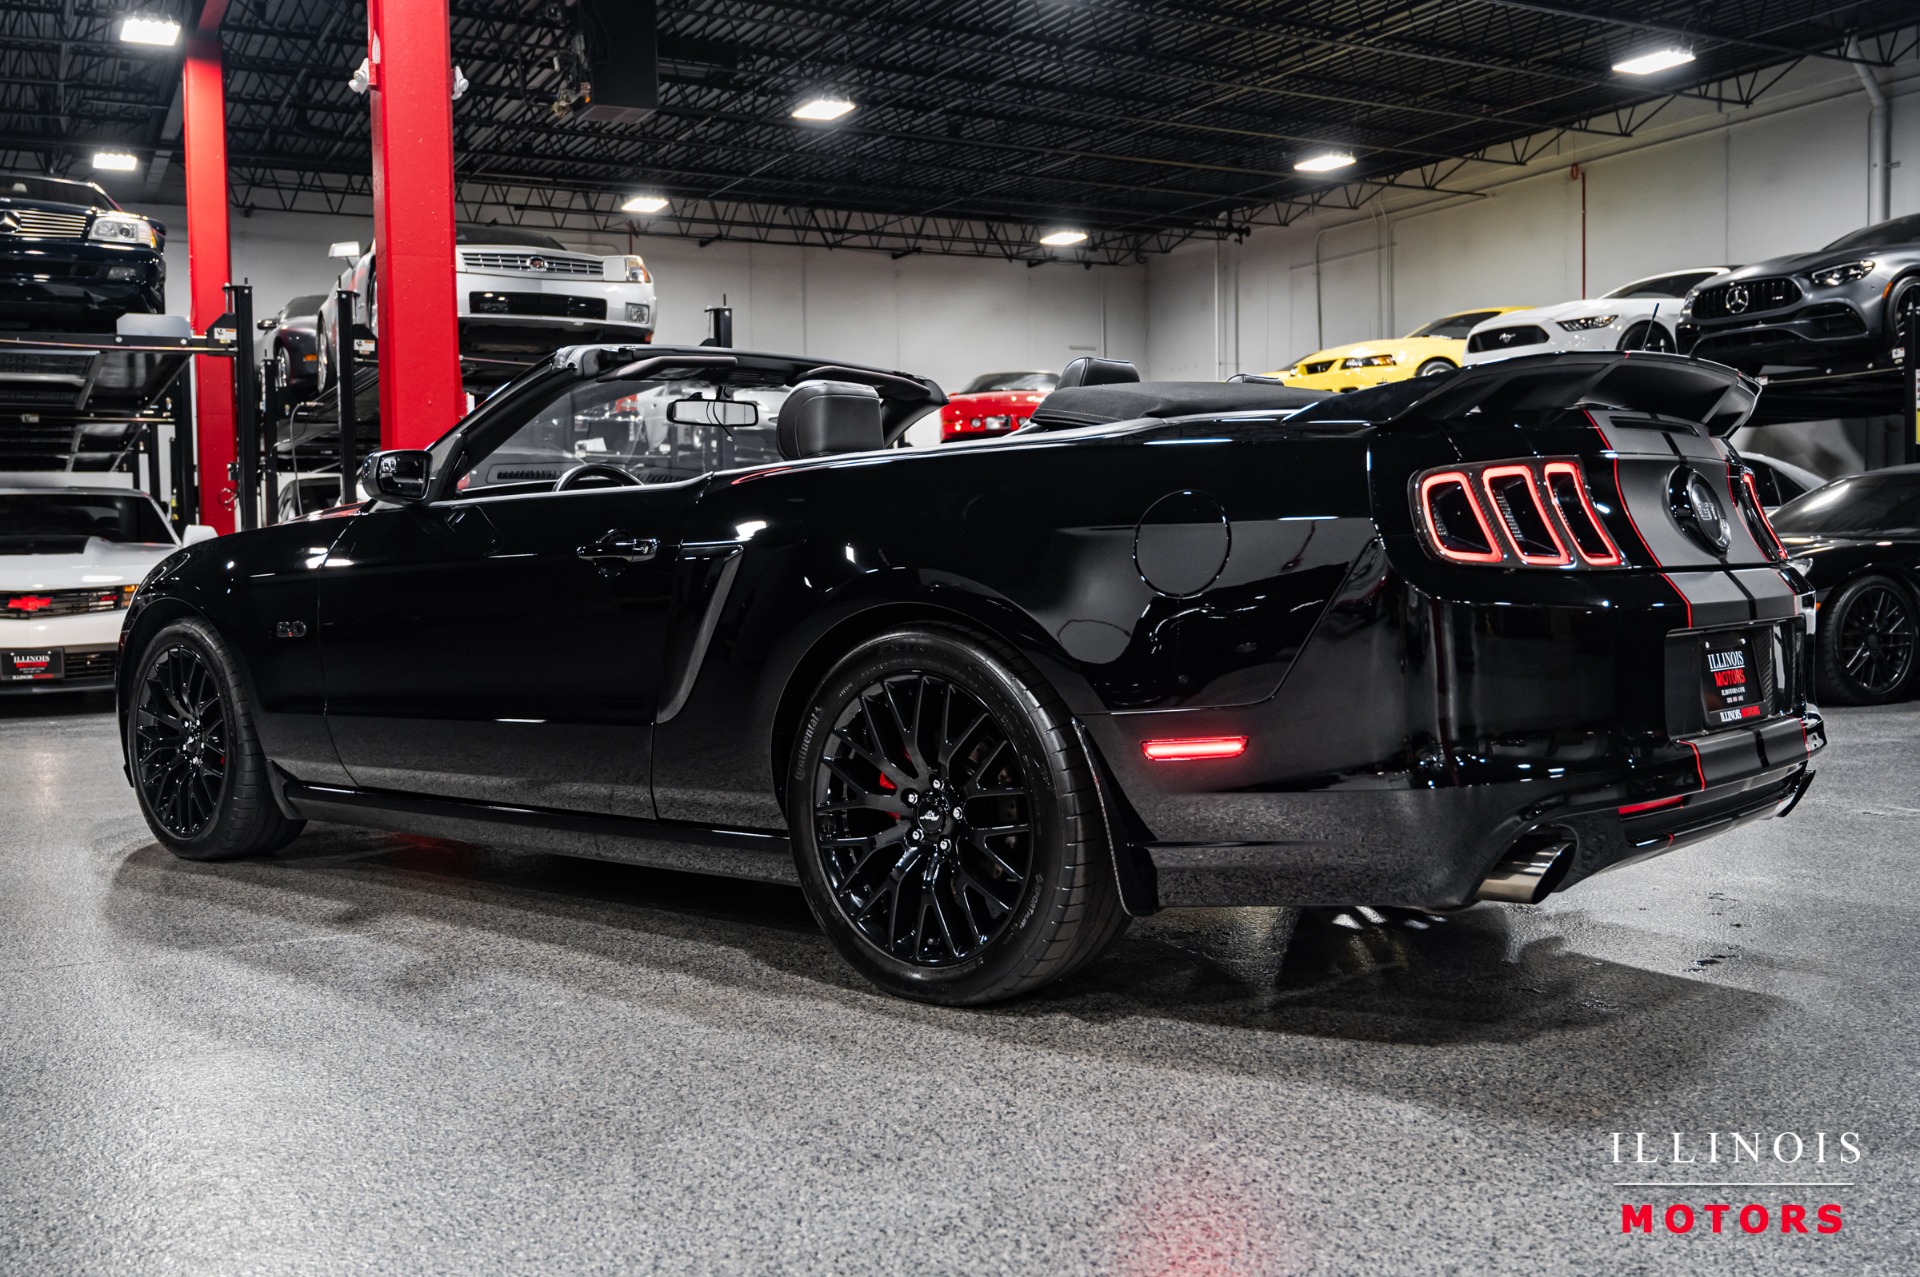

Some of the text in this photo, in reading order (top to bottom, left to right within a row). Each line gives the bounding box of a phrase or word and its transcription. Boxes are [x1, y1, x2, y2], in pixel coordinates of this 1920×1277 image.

[276, 621, 307, 638] 5.0
[13, 655, 50, 663] ILLINOIS
[1707, 650, 1745, 669] ILLINOIS
[1714, 669, 1746, 687] MOTORS
[1719, 709, 1742, 723] ILLINOIS
